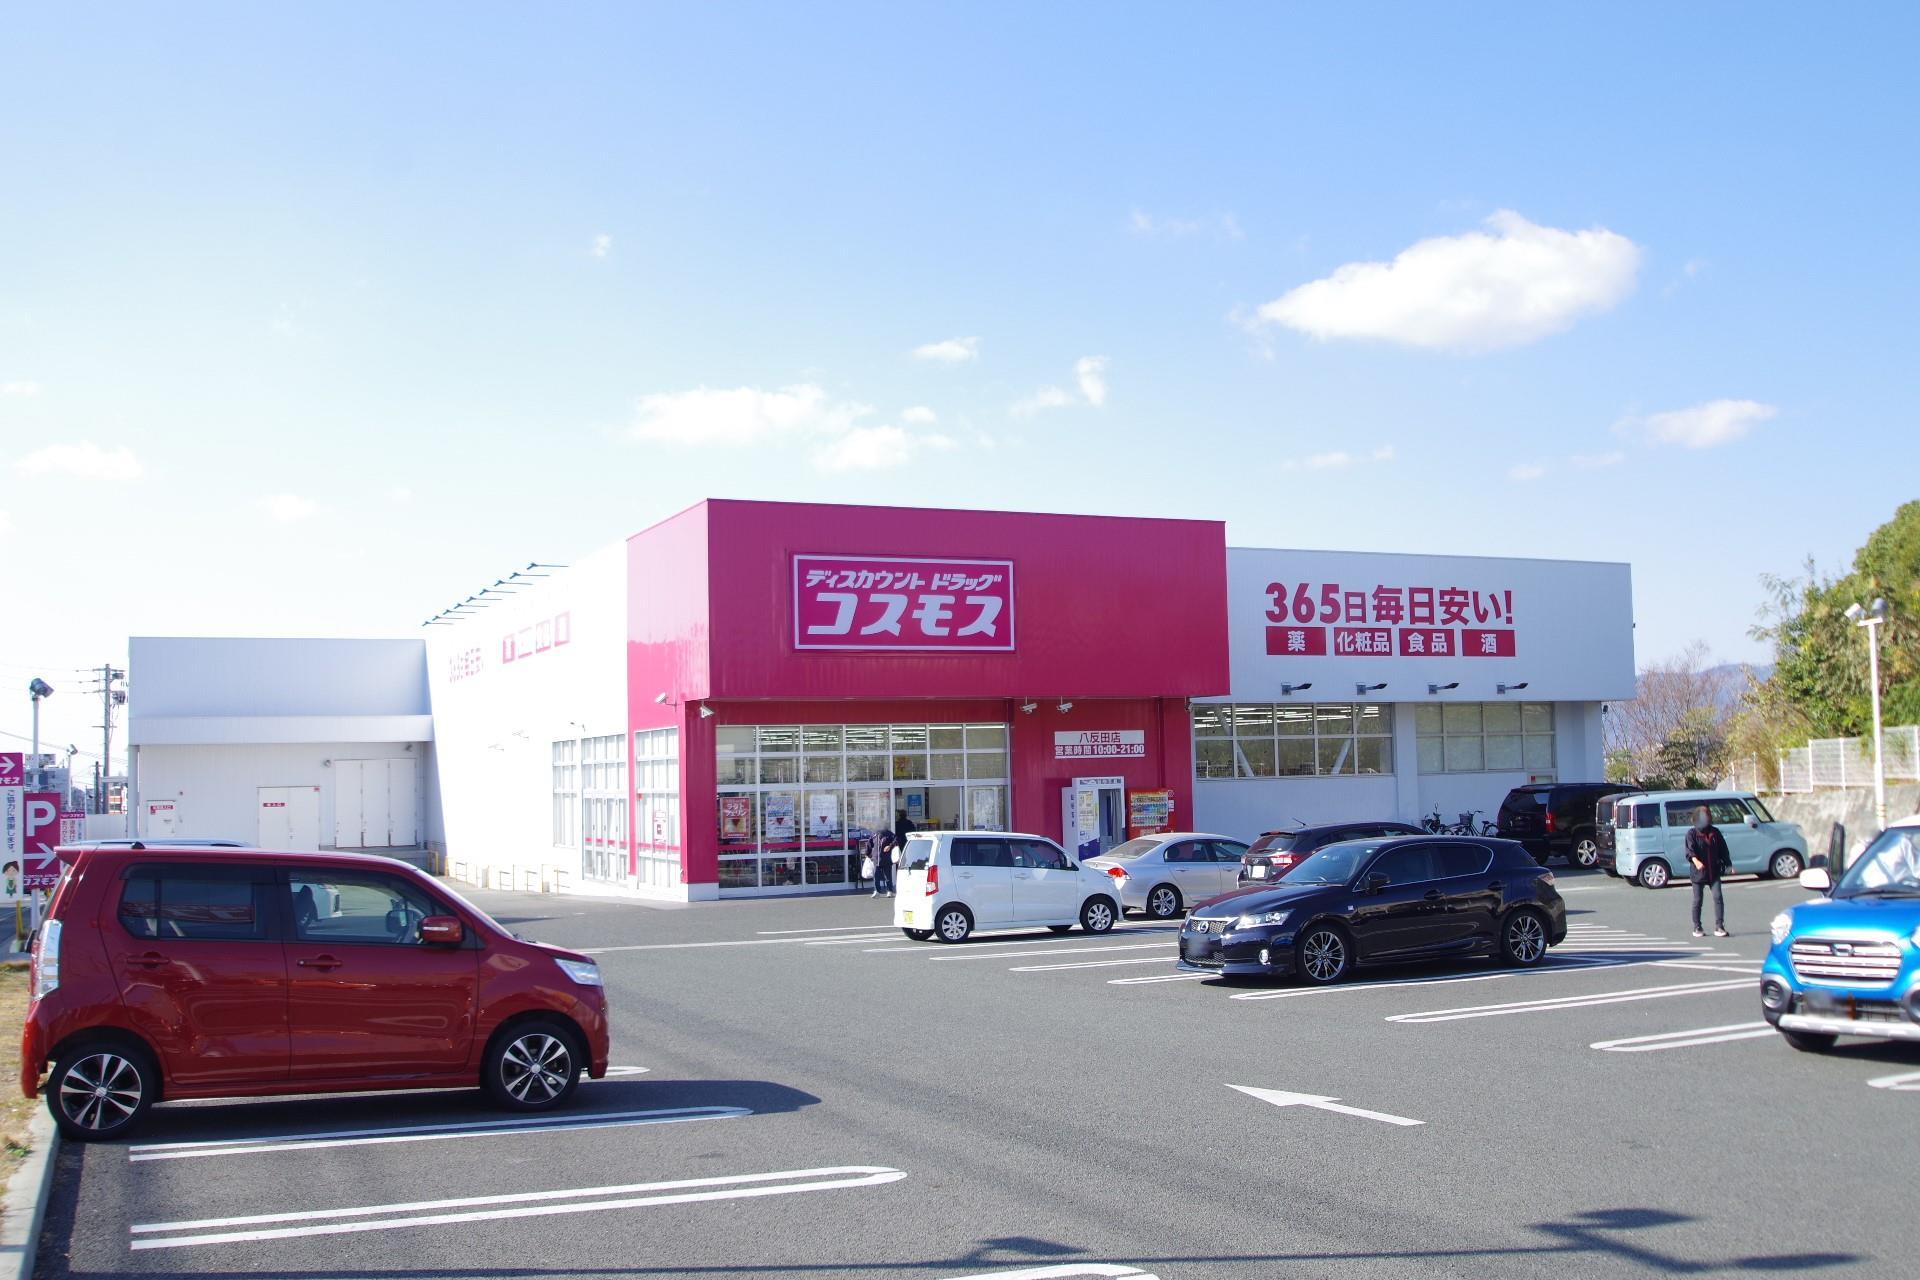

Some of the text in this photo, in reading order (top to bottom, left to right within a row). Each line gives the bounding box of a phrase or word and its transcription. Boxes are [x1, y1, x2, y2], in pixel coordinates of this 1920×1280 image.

[806, 569, 1003, 591] ディスカウント ドラッグ
[807, 592, 1003, 638] コスモス
[1287, 630, 1498, 654] 薬 化粧品 食品 酒
[1079, 732, 1121, 744] 八反田店
[0, 776, 20, 785] モス
[26, 800, 56, 837] P
